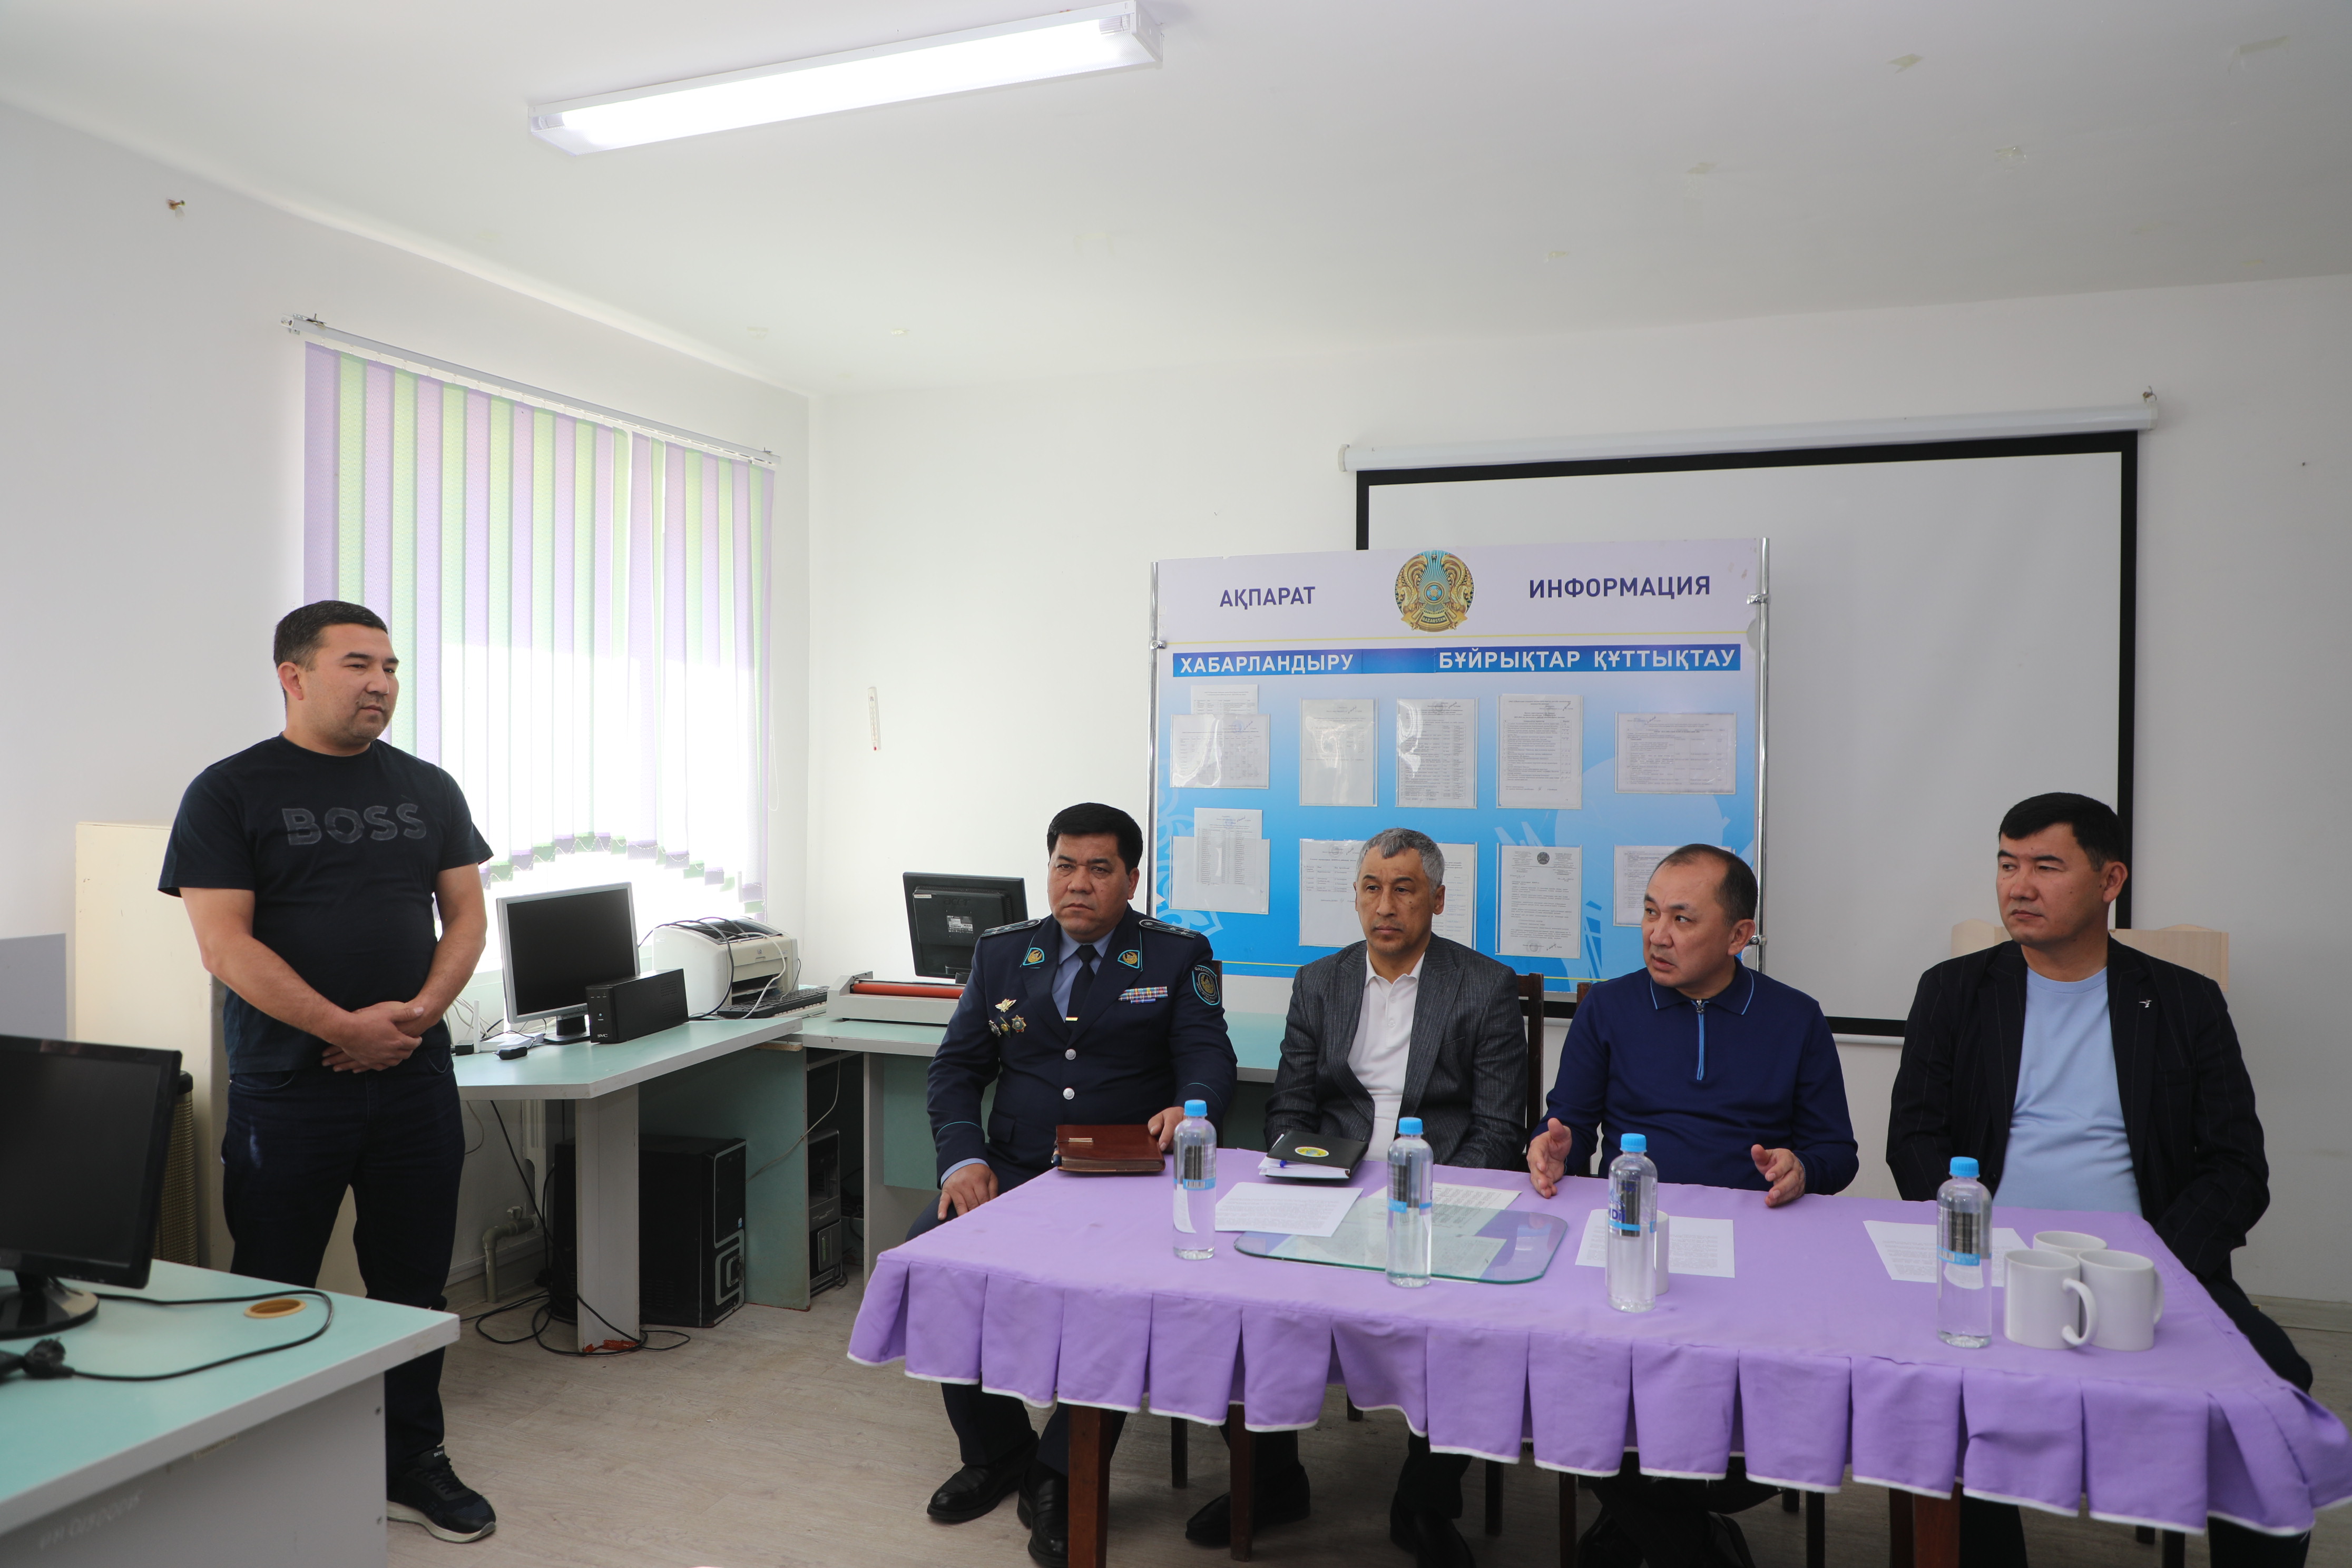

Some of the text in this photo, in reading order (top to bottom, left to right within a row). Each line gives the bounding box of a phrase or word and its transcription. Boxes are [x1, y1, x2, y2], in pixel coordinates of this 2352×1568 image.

[1220, 586, 1316, 611] АҚПАРАТ
[1529, 576, 1710, 600] ИНФОРМАЦИЯ
[1181, 654, 1354, 674] ХАБАРЛАНДЫРУ
[1440, 647, 1735, 671] БҰЙРЫҚТАР ҚҰТТЫҚТАУ
[282, 803, 426, 846] BOSS
[944, 897, 971, 906] acer
